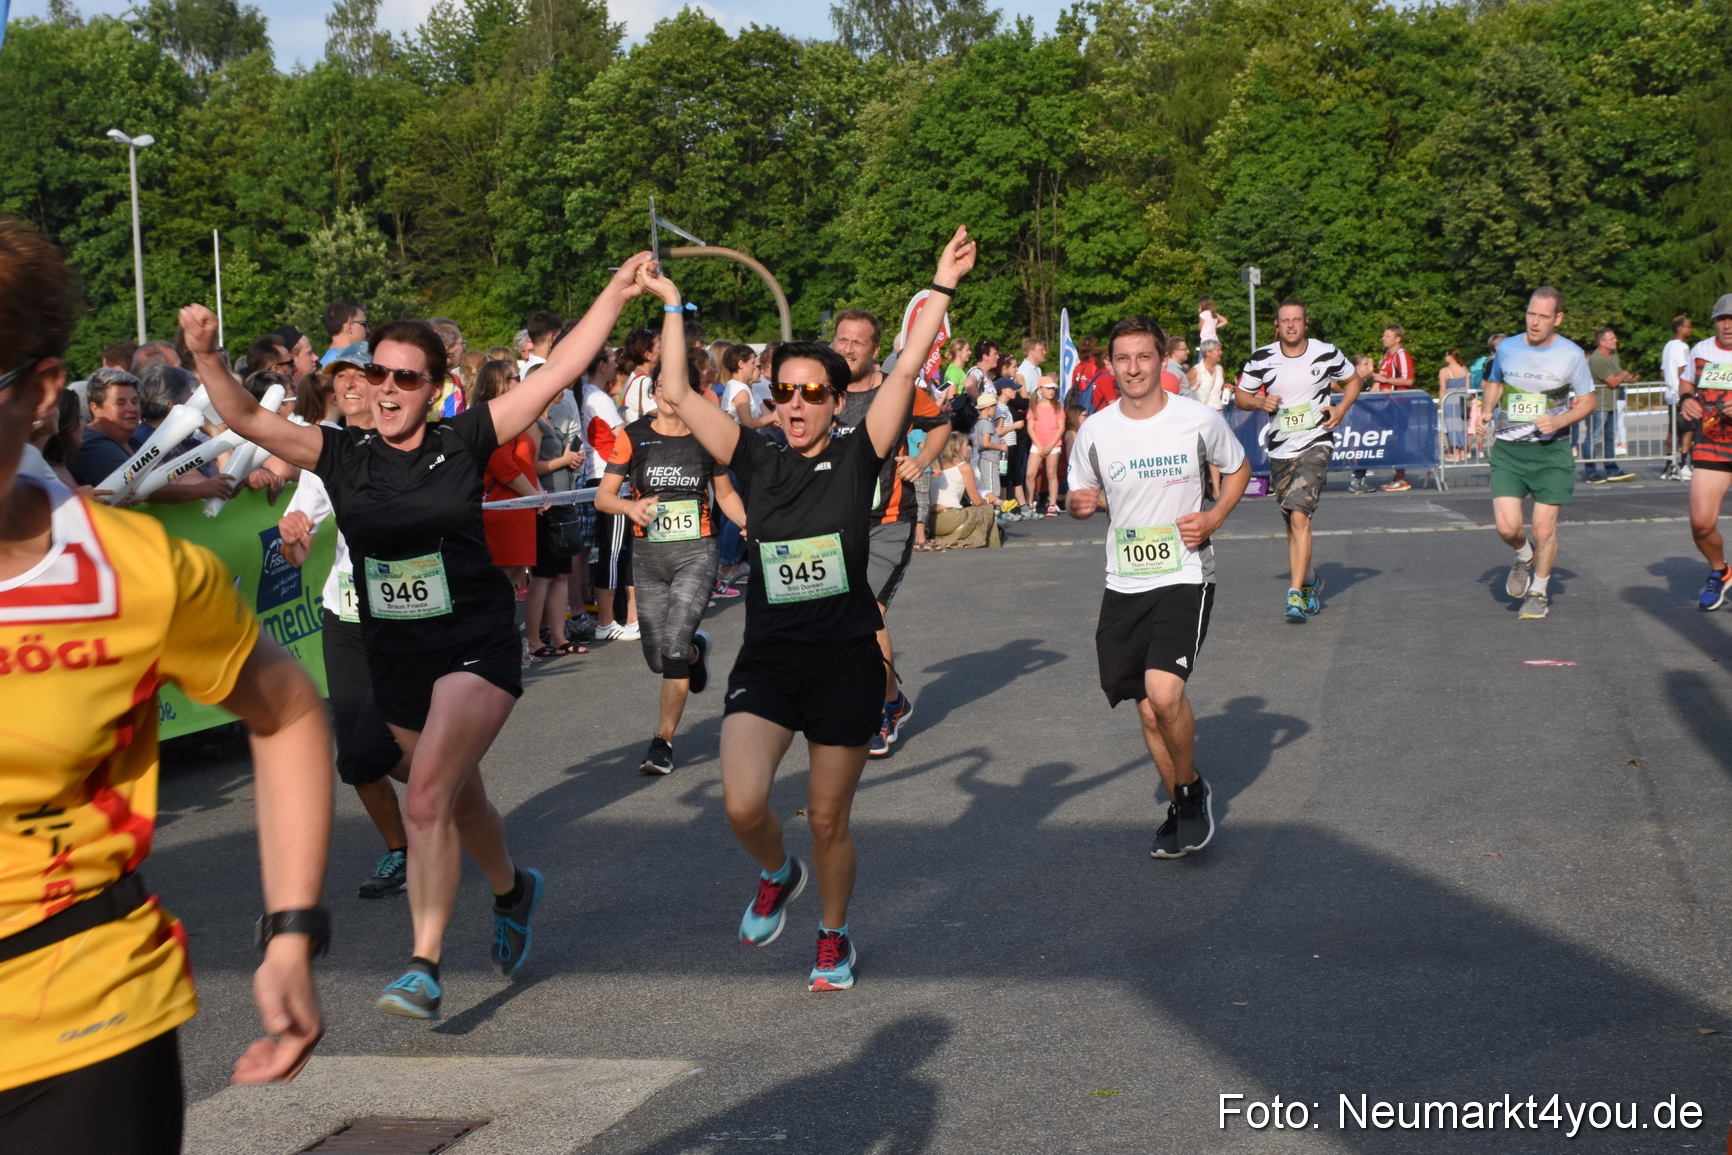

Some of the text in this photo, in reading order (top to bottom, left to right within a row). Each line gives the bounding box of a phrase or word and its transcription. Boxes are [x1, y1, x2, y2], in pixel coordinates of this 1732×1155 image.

[1512, 403, 1539, 414] 1951
[1285, 413, 1305, 426] 797
[1333, 426, 1394, 448] cher
[1130, 454, 1188, 470] HAUBNER
[646, 466, 682, 477] HECK
[1138, 467, 1182, 479] TREPPEN
[650, 476, 700, 487] DESIGN
[653, 514, 693, 531] 1015
[1123, 542, 1170, 562] 1008
[779, 560, 826, 585] 945
[381, 580, 429, 603] 946
